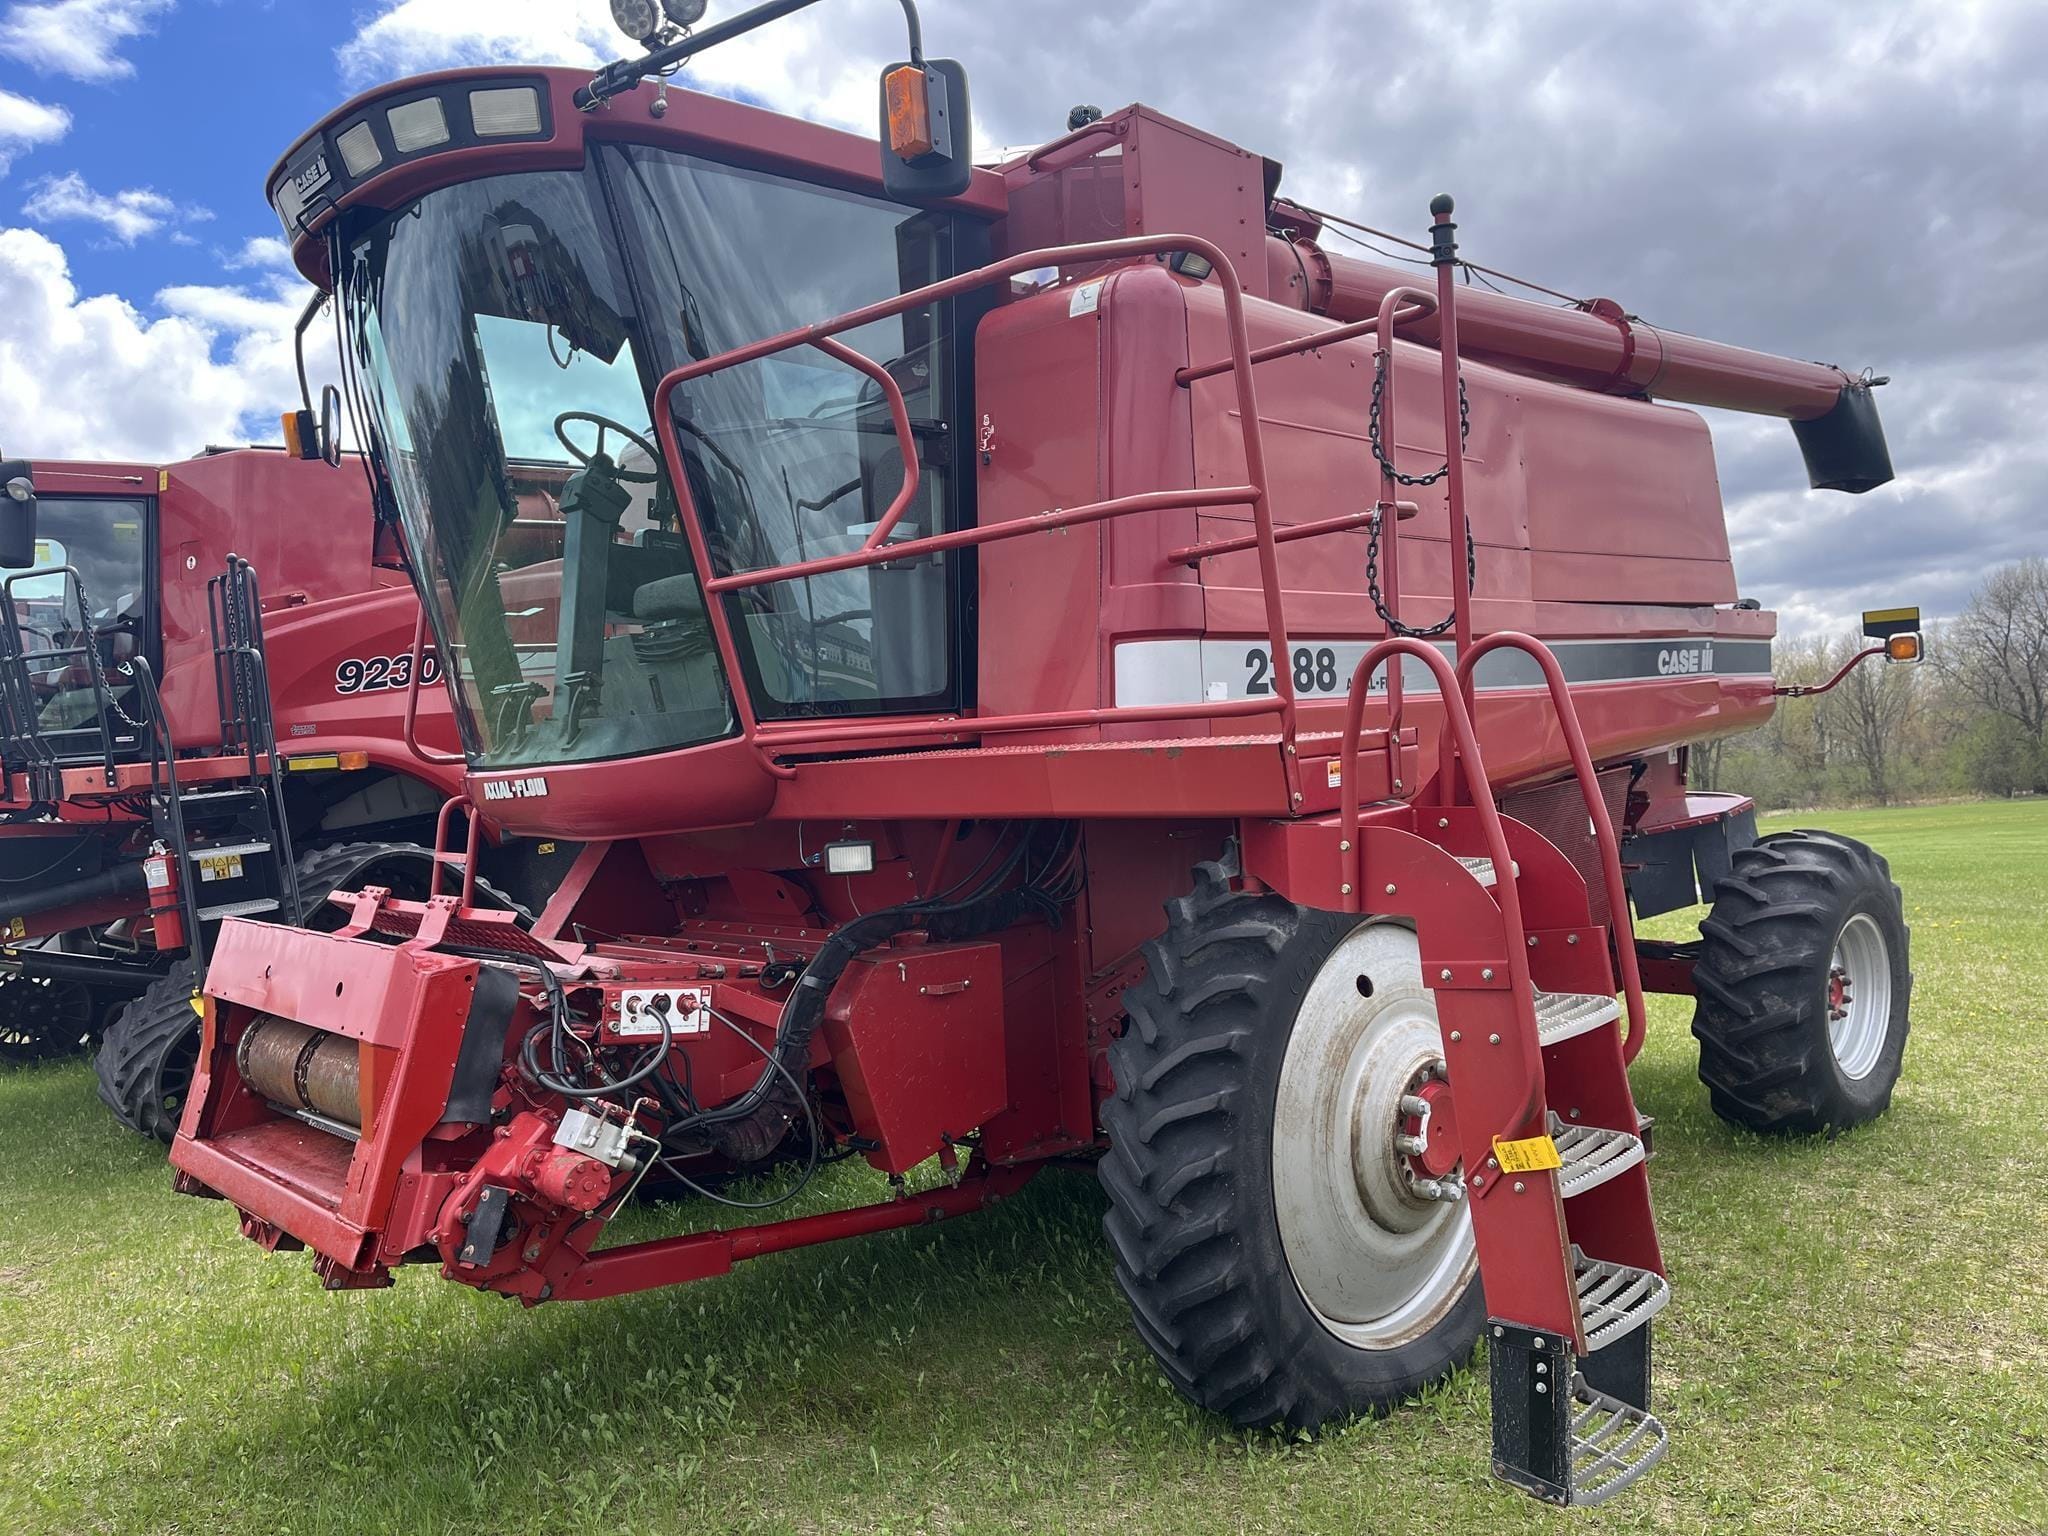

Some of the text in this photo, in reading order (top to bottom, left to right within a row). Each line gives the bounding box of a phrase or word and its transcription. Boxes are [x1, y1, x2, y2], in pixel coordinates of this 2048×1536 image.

[295, 164, 320, 193] CASE
[335, 653, 443, 695] 9230
[1658, 649, 1699, 675] CASE
[483, 777, 548, 800] AXIAL-FLOW
